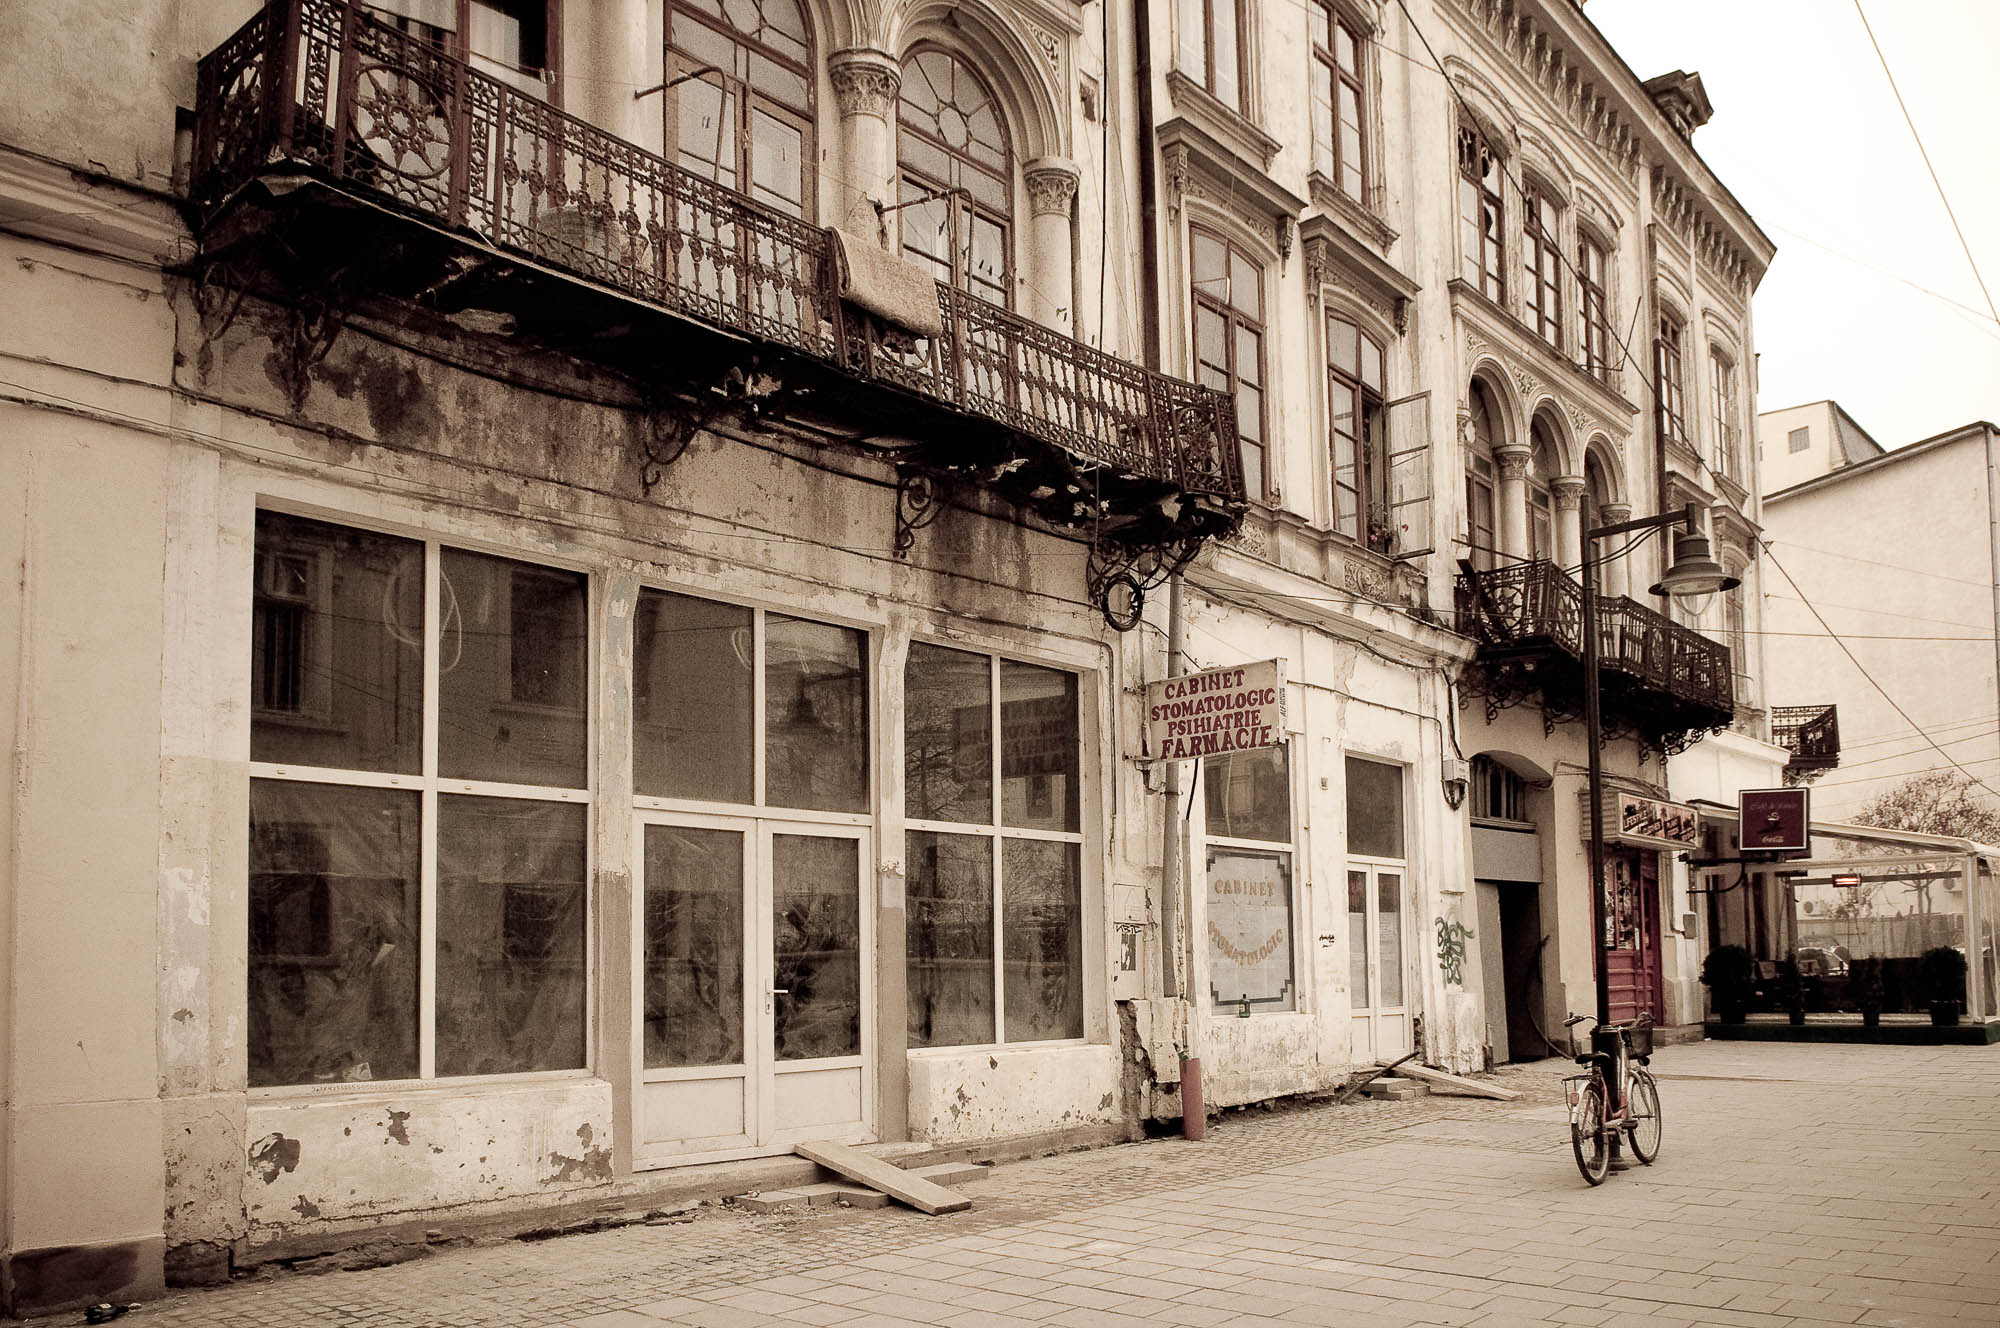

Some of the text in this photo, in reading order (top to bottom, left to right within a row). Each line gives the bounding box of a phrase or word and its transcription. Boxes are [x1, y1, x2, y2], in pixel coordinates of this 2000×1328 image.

[1165, 669, 1245, 699] CABINET
[1152, 687, 1275, 721] STOMATOLOGIC
[1168, 709, 1261, 737] PSIHIATRIE
[1161, 725, 1272, 759] FARMACIE
[1214, 879, 1274, 897] CABINET
